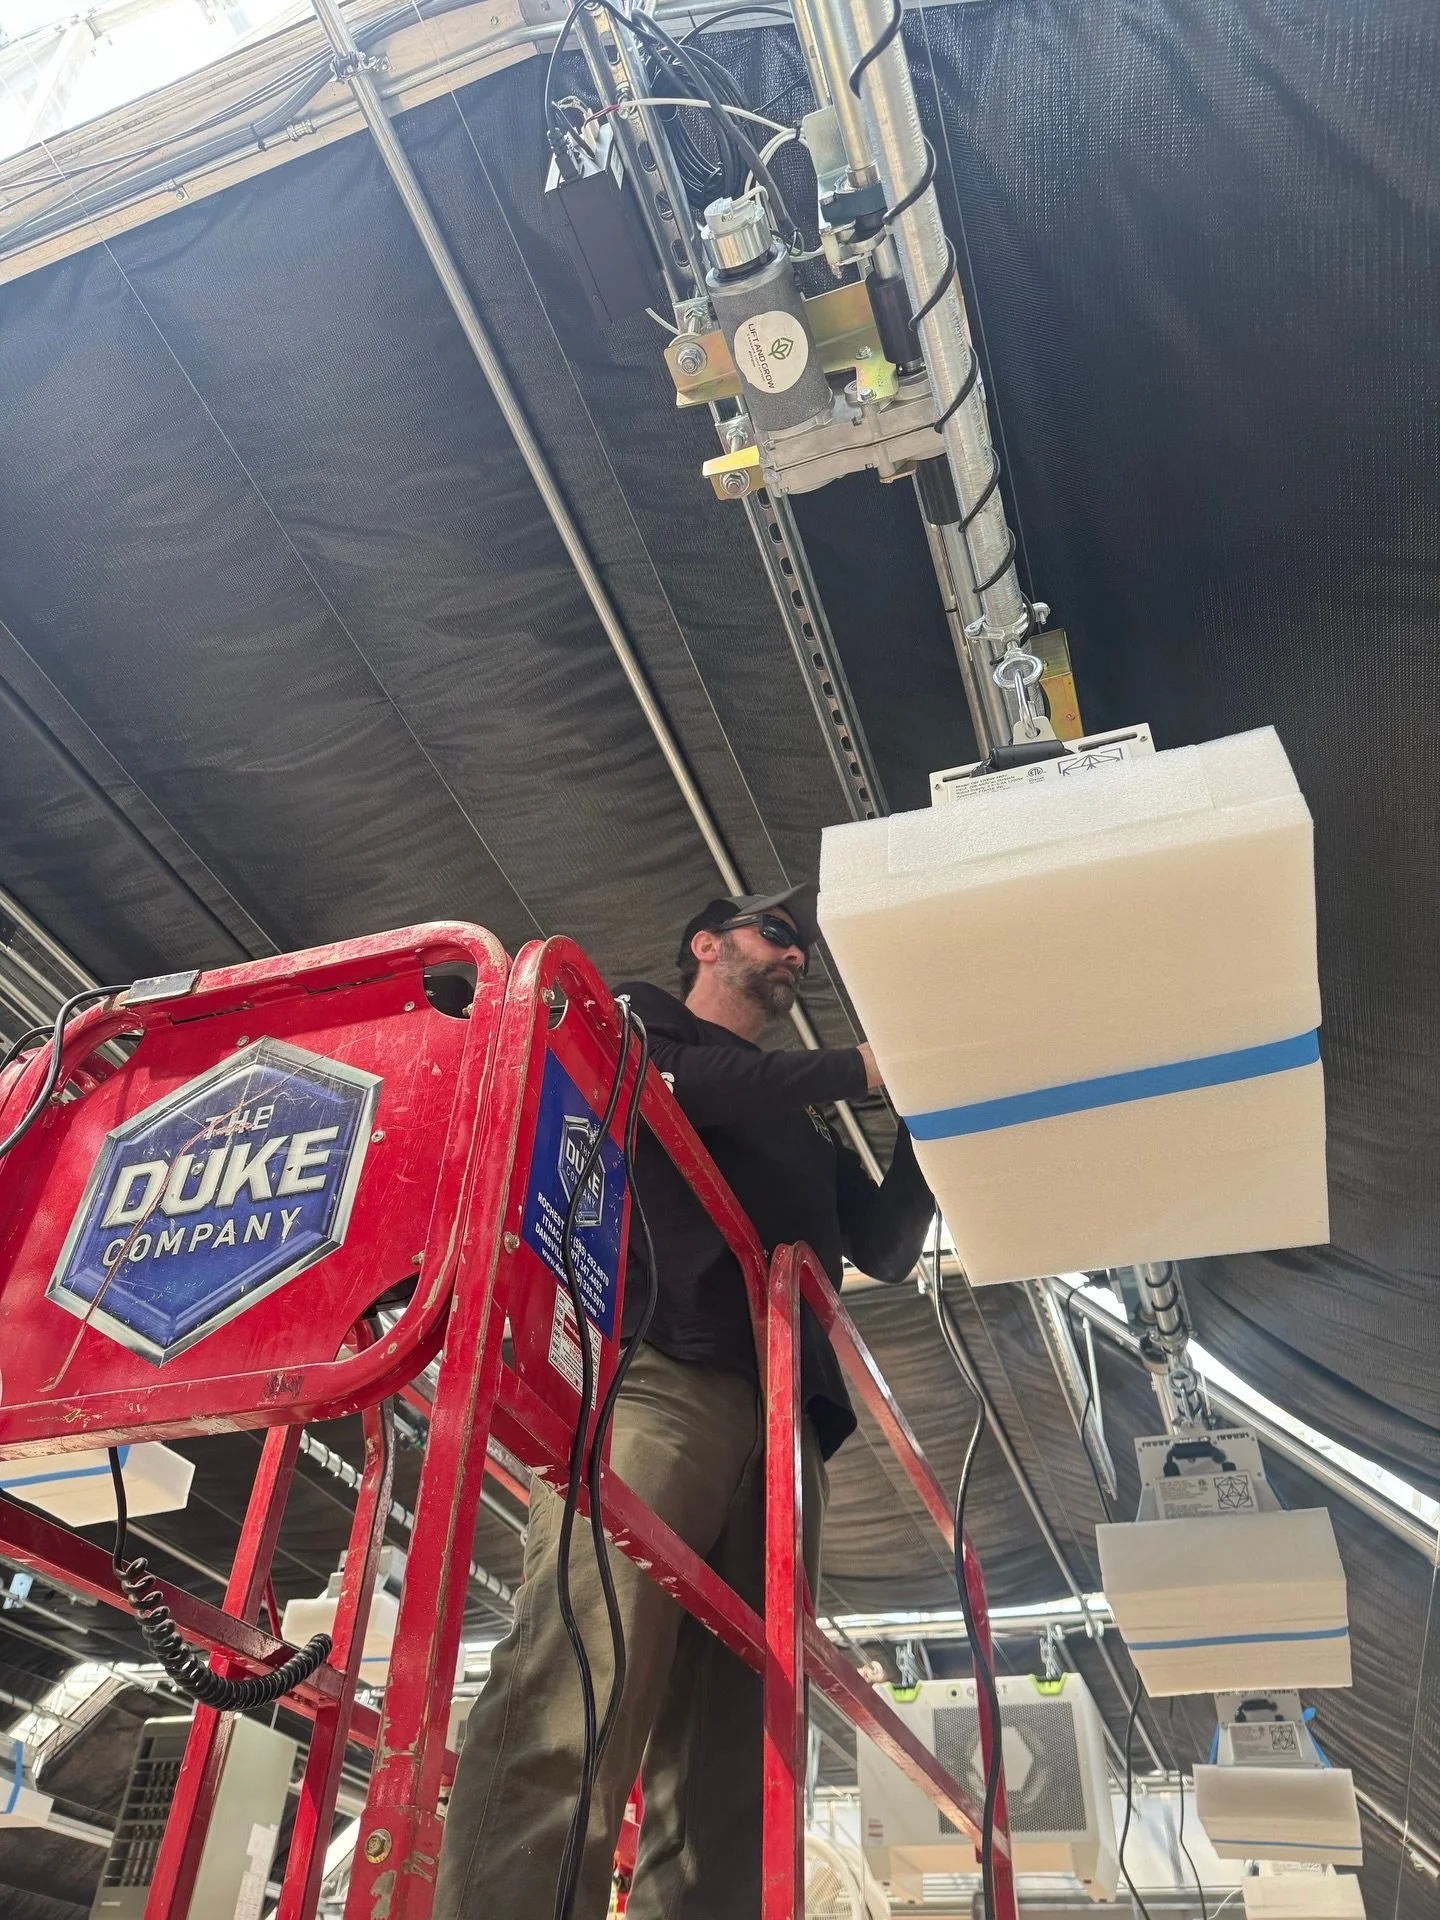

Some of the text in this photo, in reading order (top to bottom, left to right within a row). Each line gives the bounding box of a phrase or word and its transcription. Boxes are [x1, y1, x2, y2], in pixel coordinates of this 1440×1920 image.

[748, 323, 759, 342] LIFT
[754, 344, 766, 362] AND
[761, 362, 775, 389] GROW
[203, 1103, 275, 1141] THE
[100, 1125, 340, 1230] DUKE
[566, 1166, 595, 1208] COANY
[102, 1206, 302, 1268] COMPANY
[538, 1191, 573, 1241] ROCHEST:
[535, 1222, 564, 1264] DANSVILL
